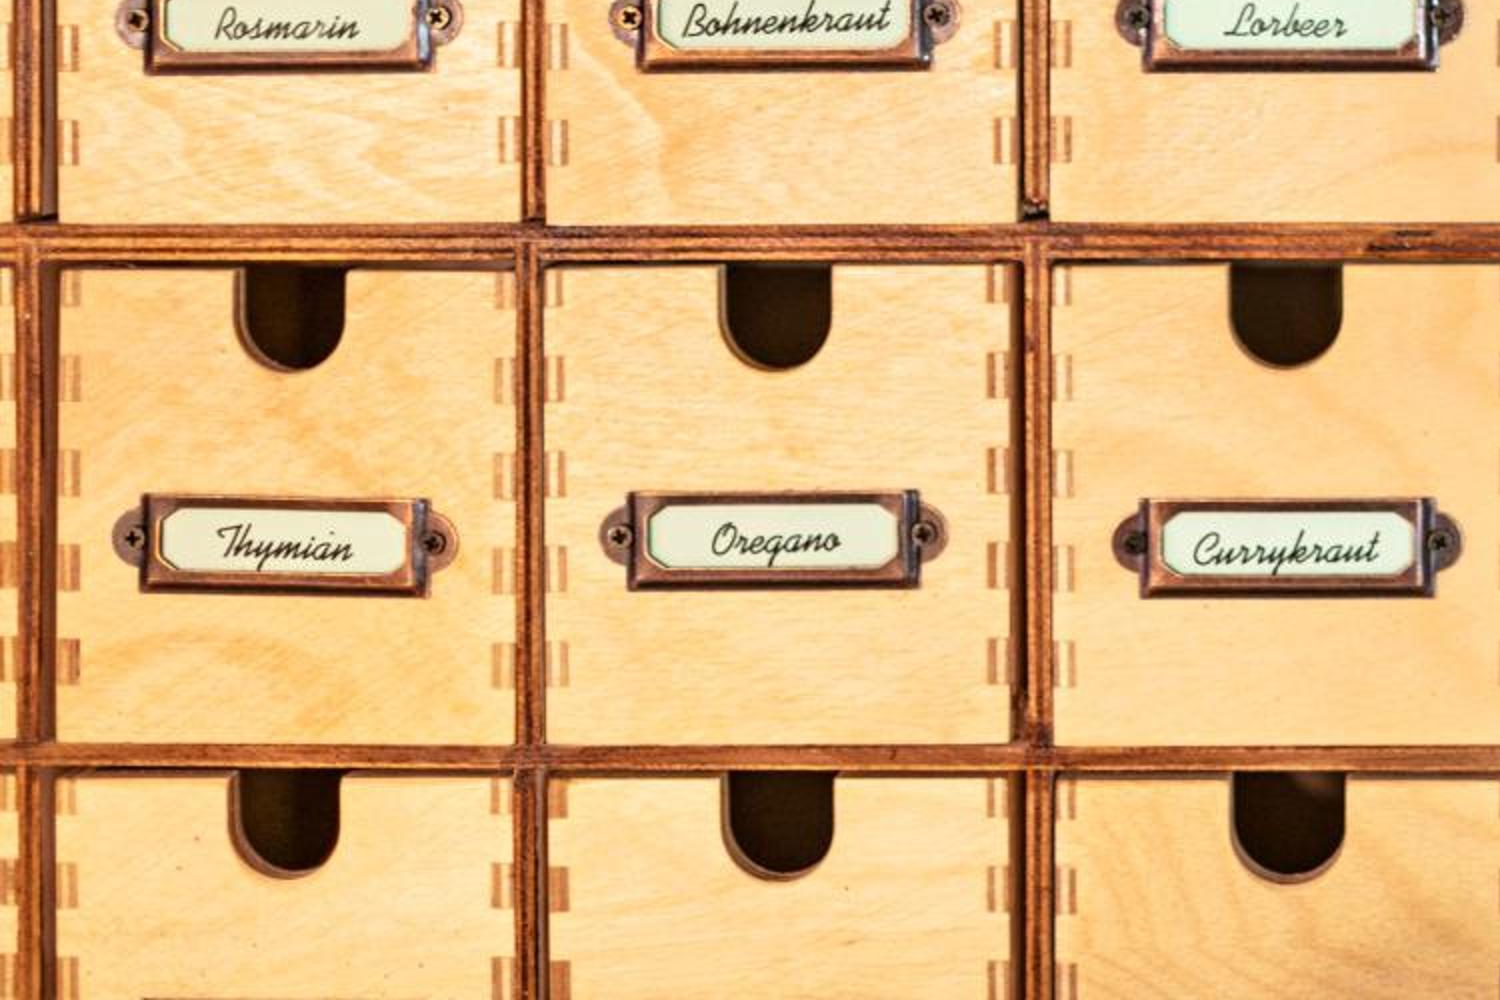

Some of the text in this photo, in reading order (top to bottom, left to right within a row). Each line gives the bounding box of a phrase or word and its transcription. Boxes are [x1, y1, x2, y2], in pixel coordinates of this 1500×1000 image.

[214, 6, 361, 40] Rosmarin
[1223, 2, 1347, 38] Lorbeer
[216, 523, 354, 572] Thymian
[711, 522, 842, 568] Oregano
[1193, 529, 1380, 576] Currykraut
